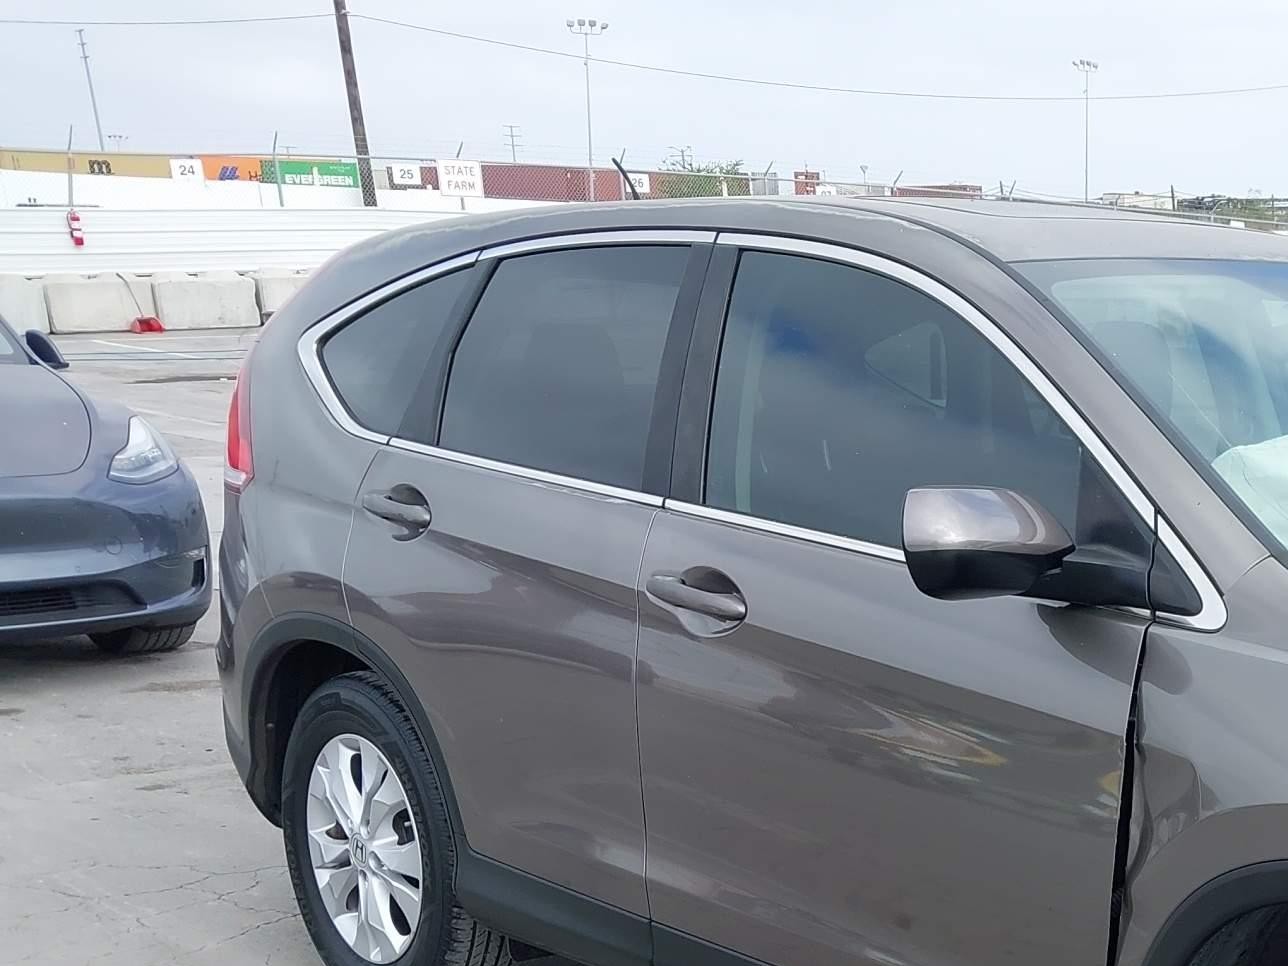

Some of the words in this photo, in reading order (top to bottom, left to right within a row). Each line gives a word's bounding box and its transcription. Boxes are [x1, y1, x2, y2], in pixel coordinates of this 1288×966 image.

[178, 164, 195, 176] 24
[399, 168, 415, 180] 25
[443, 164, 476, 177] STATE
[447, 179, 476, 192] FARM
[631, 177, 645, 188] 26
